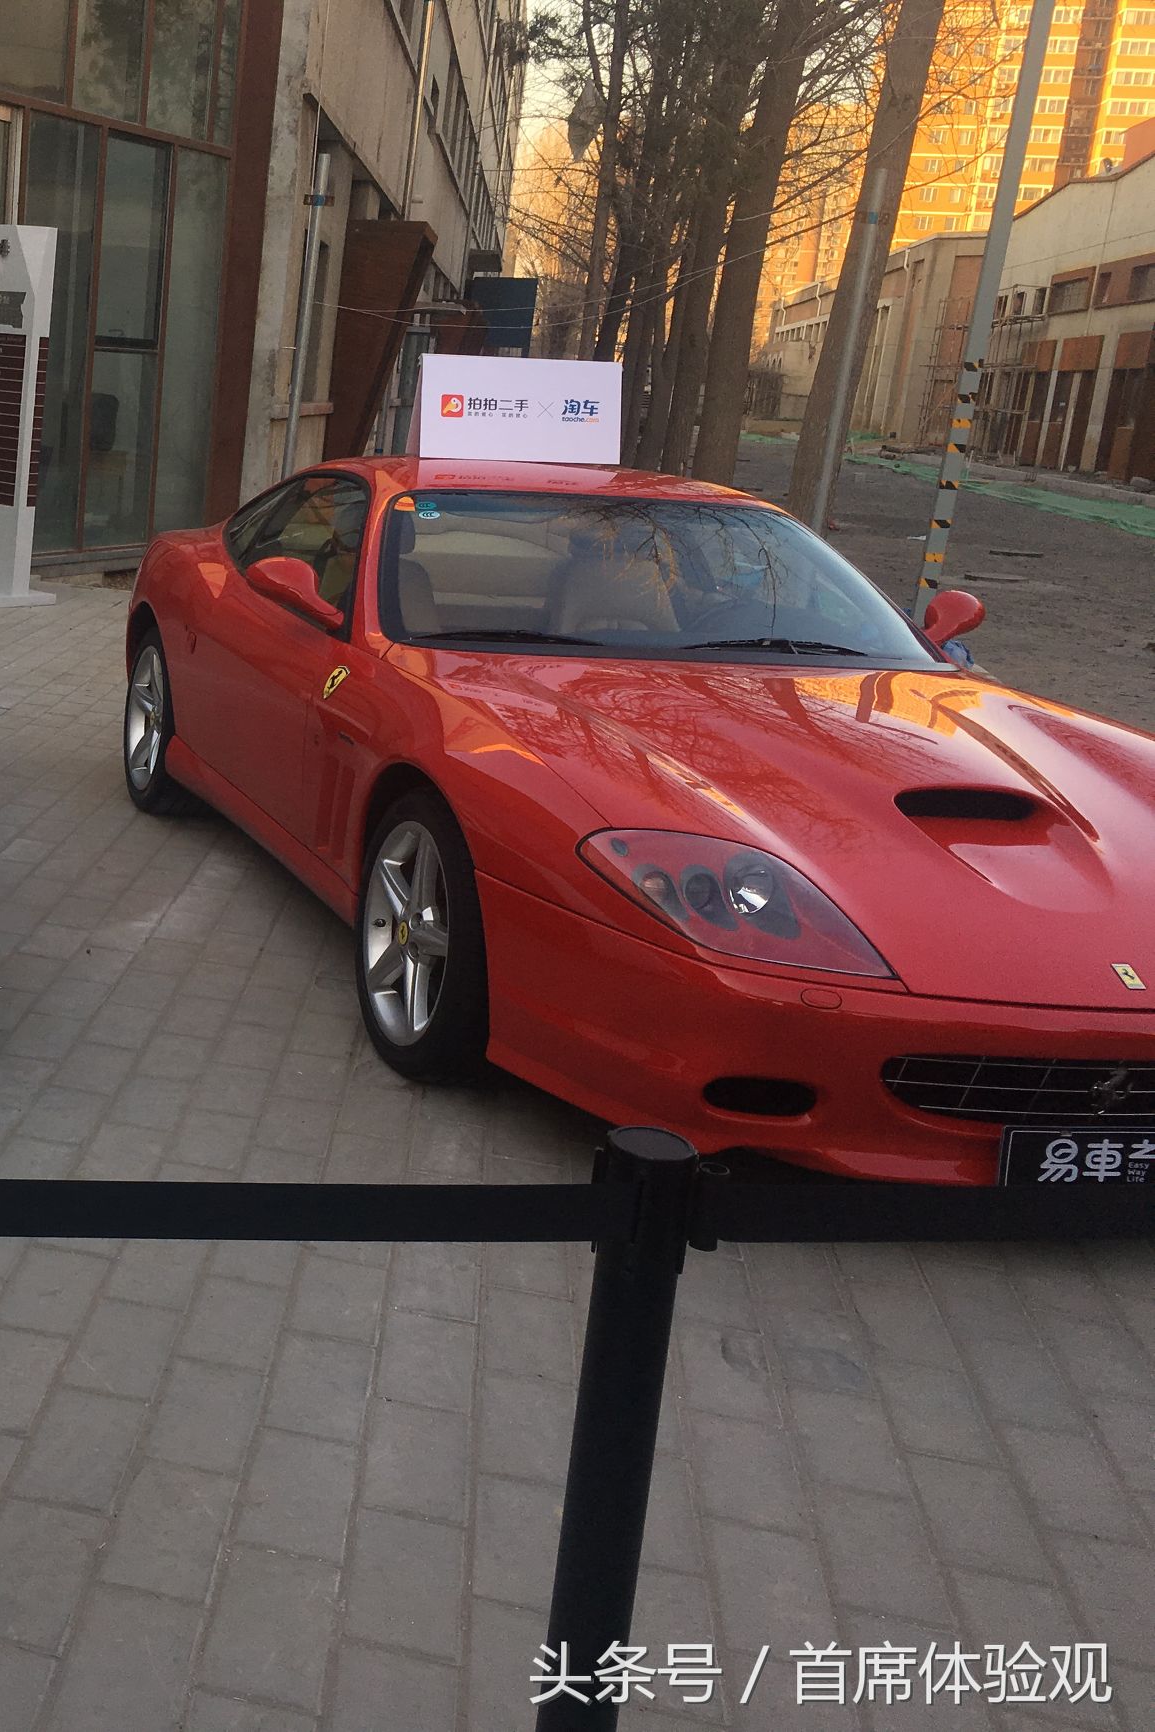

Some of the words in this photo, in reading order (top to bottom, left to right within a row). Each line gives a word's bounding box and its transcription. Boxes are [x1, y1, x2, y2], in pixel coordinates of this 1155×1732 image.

[467, 397, 529, 412] 拍拍二手
[561, 399, 600, 416] 淘车
[1128, 1162, 1149, 1170] Easy
